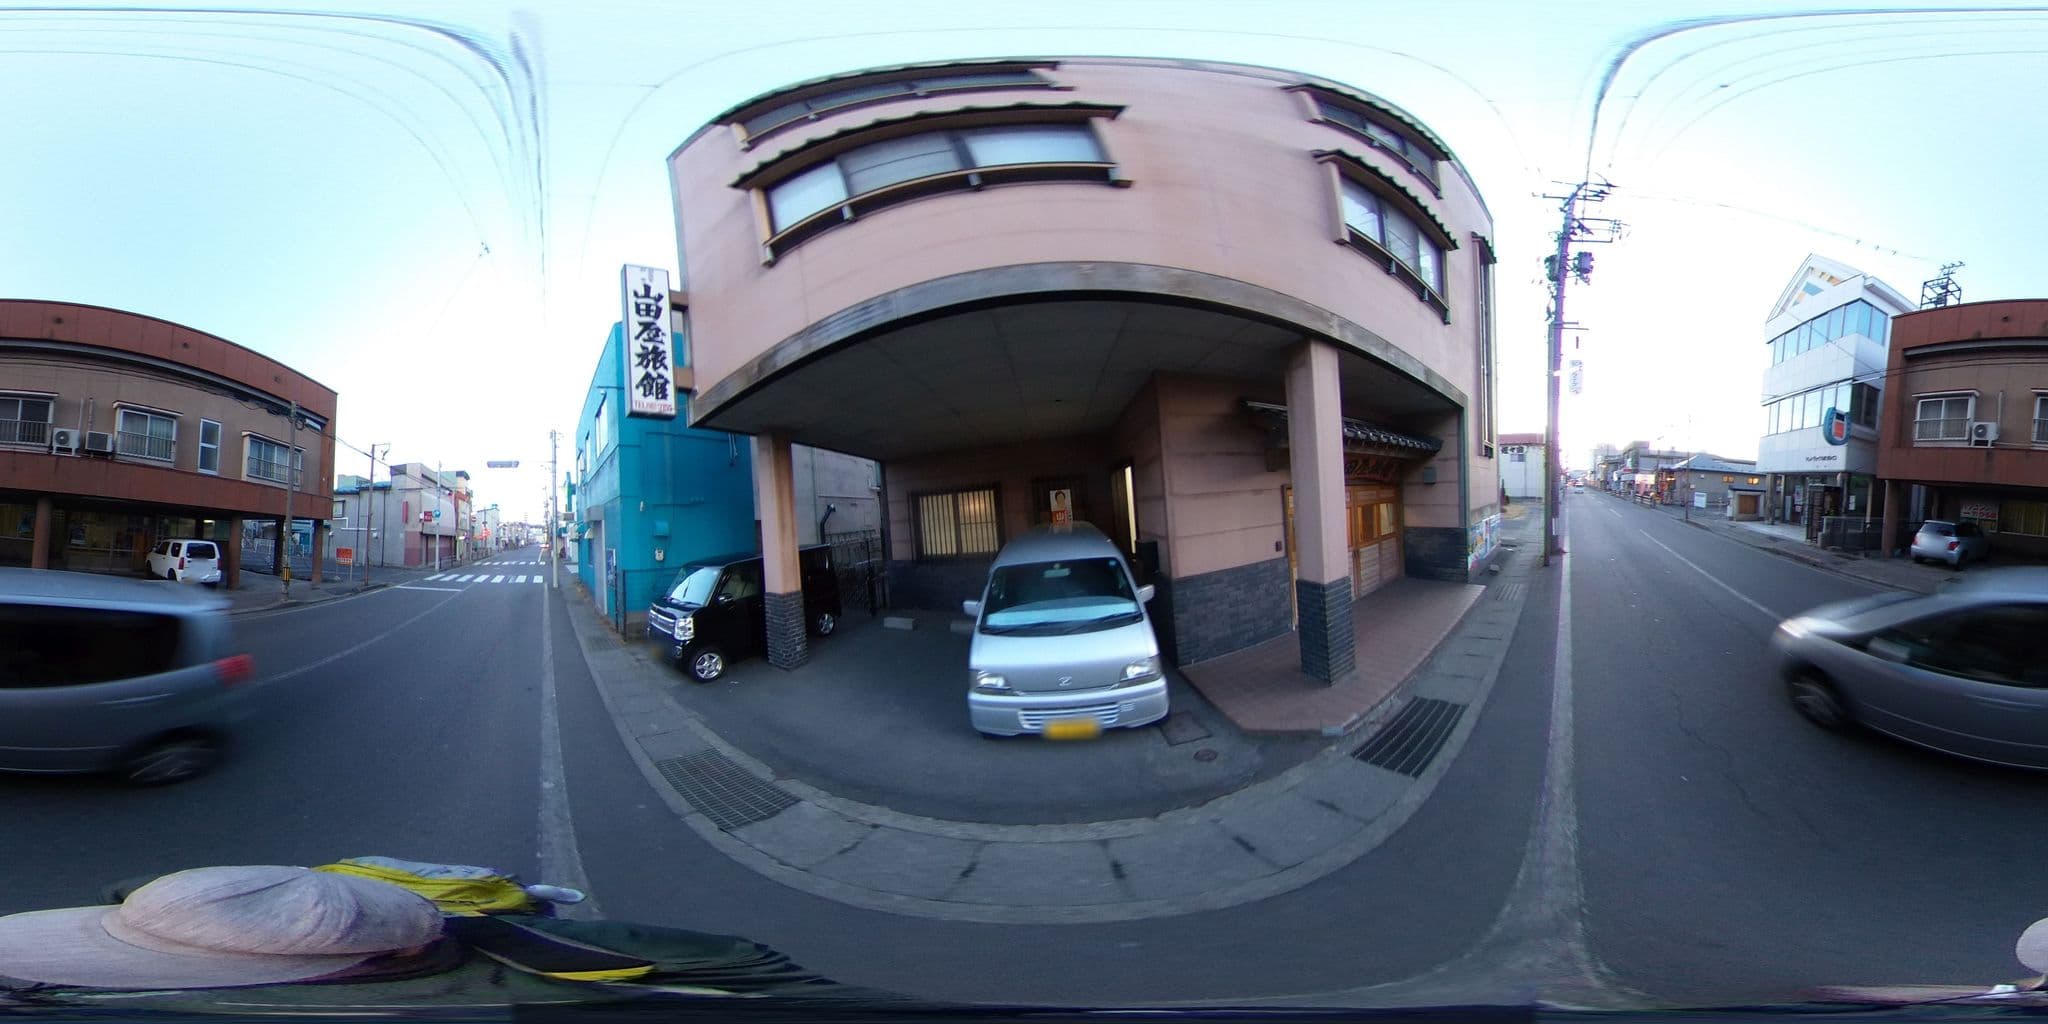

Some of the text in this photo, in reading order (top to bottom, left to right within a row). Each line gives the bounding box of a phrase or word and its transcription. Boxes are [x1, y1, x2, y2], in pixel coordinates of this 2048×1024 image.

[634, 284, 670, 400] 山田屋旅館
